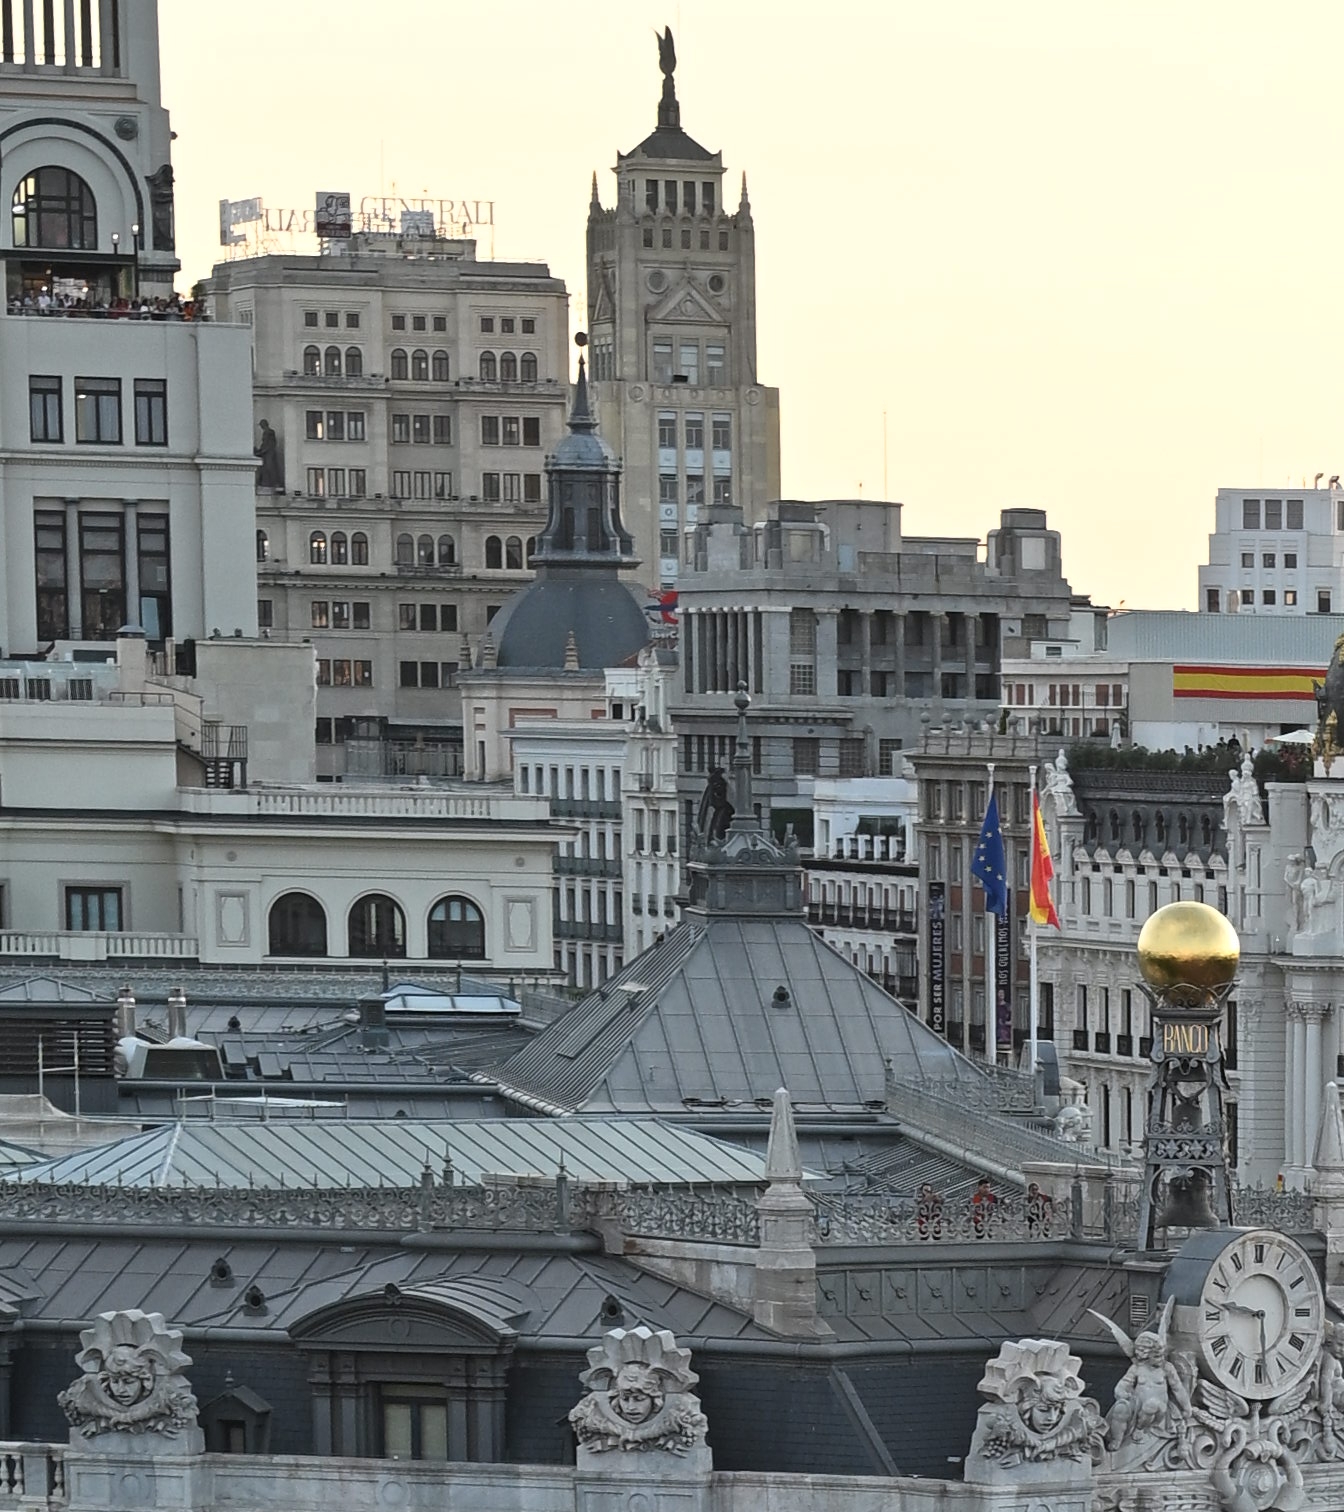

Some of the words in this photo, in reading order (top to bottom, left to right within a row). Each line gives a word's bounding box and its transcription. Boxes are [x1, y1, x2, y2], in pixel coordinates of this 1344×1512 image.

[360, 196, 496, 225] GENERALI
[932, 921, 943, 980] MUJERES
[933, 983, 943, 1002] SER
[933, 1006, 943, 1031] POR
[1164, 1024, 1208, 1053] BANCO
